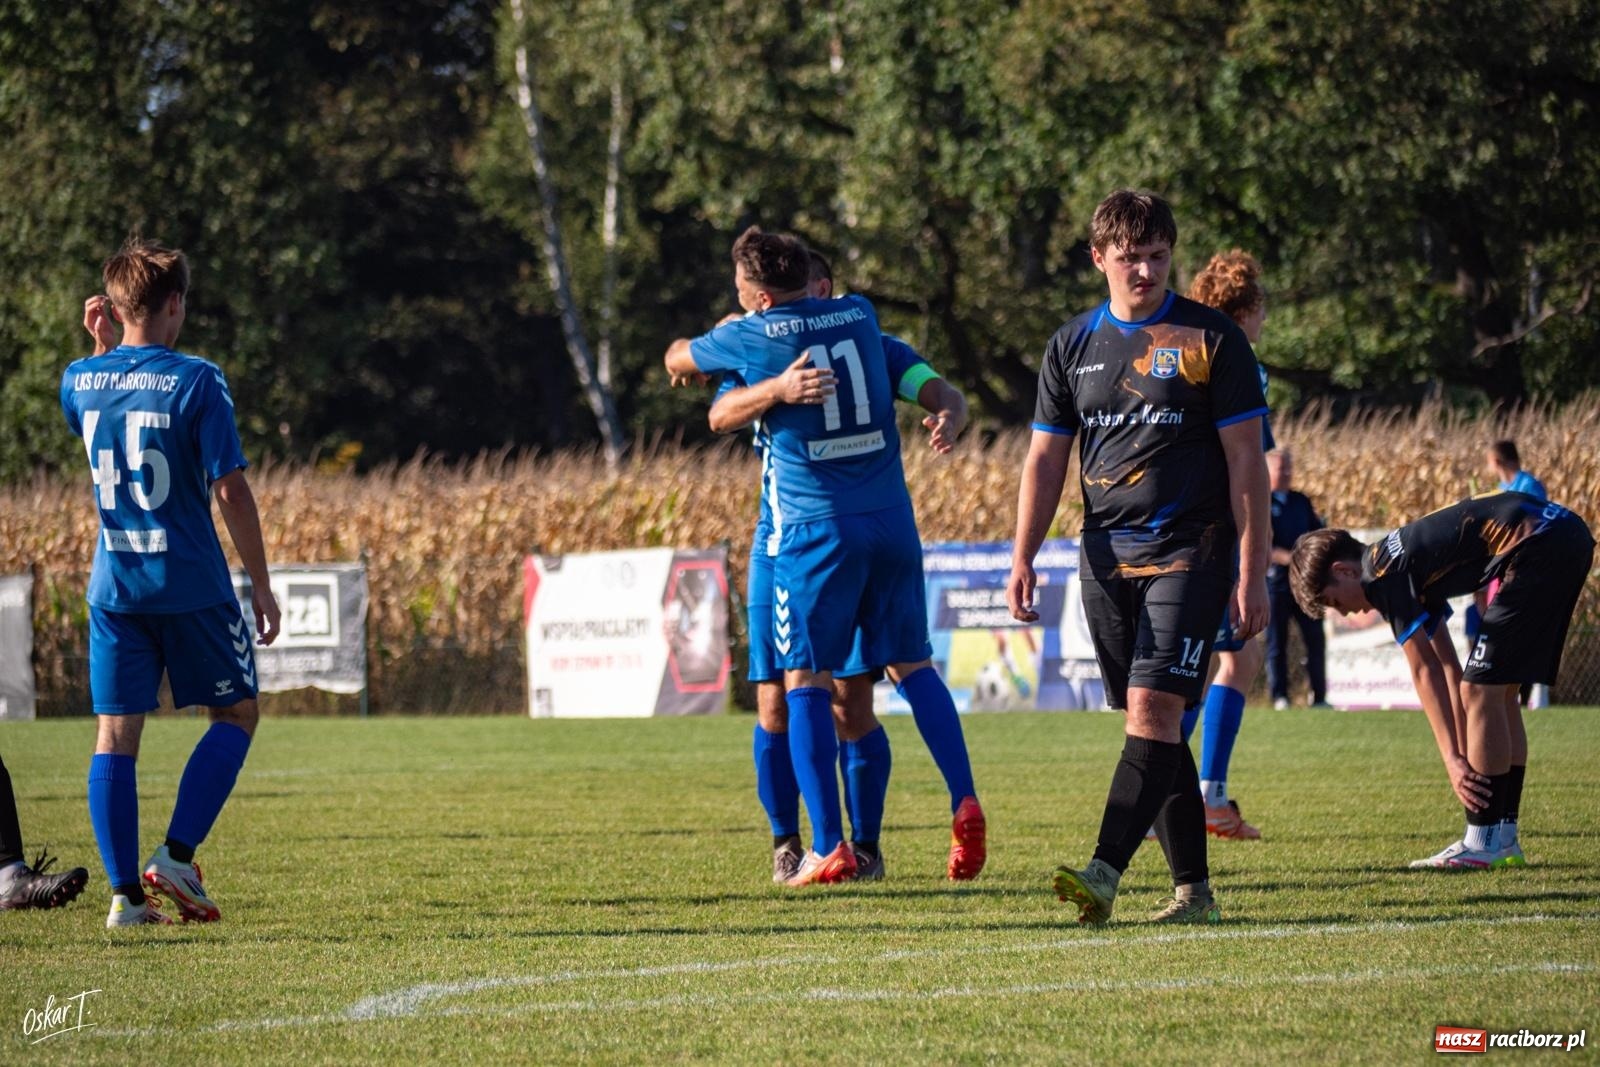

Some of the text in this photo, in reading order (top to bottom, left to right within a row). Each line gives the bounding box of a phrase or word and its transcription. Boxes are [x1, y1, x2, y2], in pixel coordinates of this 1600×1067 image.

[766, 321, 789, 338] LKS
[790, 318, 804, 334] 07
[74, 371, 179, 392] LKS 07 MARKOWICE
[803, 338, 871, 432] 11
[1129, 412, 1138, 425] z
[83, 409, 171, 511] 45
[1180, 637, 1204, 669] 14
[1474, 634, 1488, 661] 5
